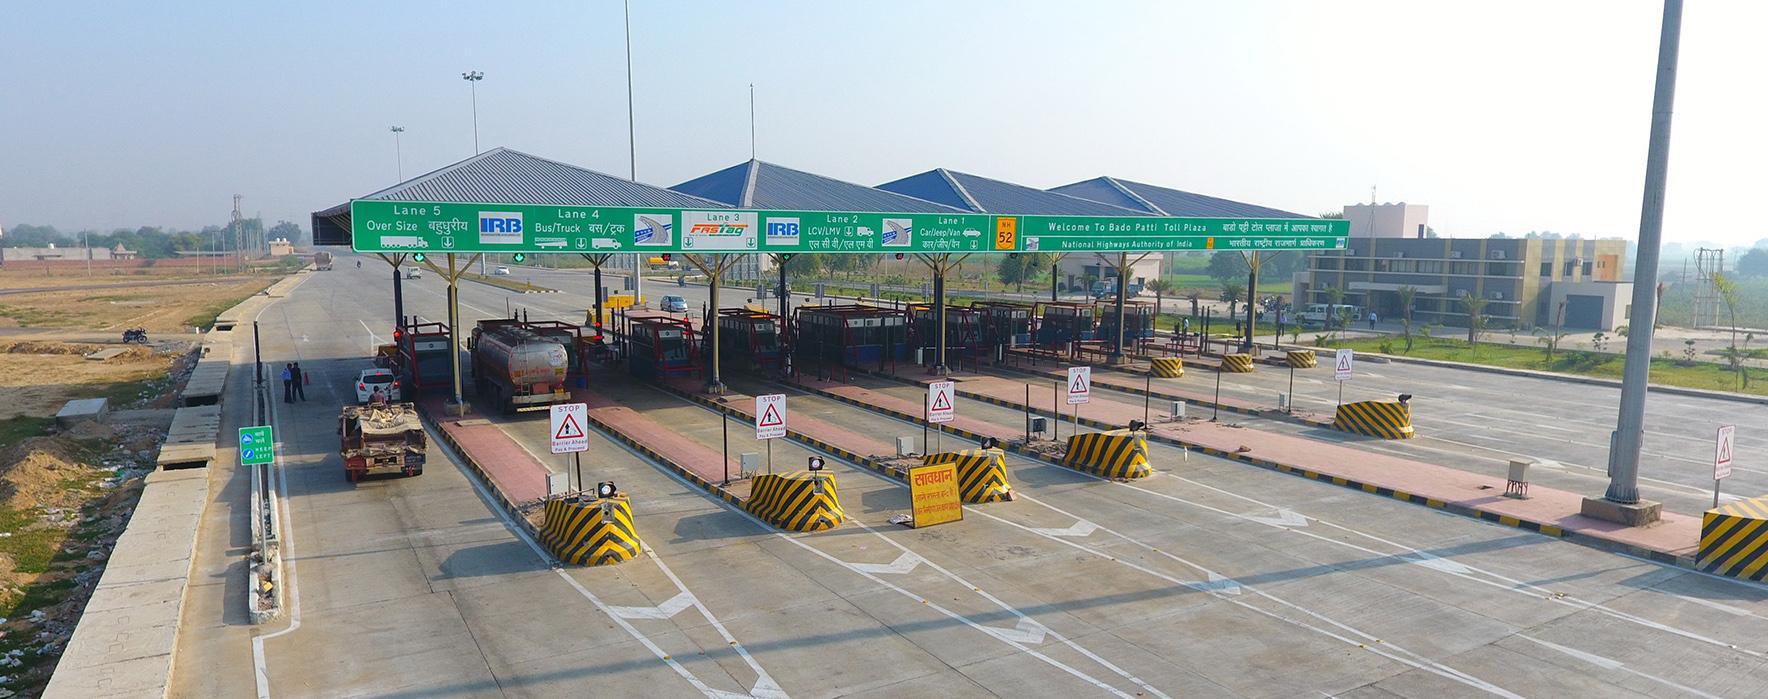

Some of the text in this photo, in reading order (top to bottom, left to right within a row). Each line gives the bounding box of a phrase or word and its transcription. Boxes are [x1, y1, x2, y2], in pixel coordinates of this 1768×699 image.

[394, 206, 441, 215] Lane 5
[558, 209, 599, 219] Lane 4
[707, 213, 729, 221] Lane
[827, 214, 858, 223] Lane 2
[938, 216, 958, 224] Lane
[366, 220, 418, 230] Over Size
[480, 218, 522, 233] IRB
[535, 223, 580, 233] Bus/Truck
[588, 223, 625, 235] बस/ट्रक
[768, 222, 799, 236] IRB
[1049, 222, 1090, 231] Welcome
[1095, 223, 1105, 232] To
[1109, 223, 1131, 232] Bado
[1135, 223, 1157, 231] Patti
[1251, 222, 1263, 232] टोल
[1311, 224, 1326, 232] स्वागत
[1328, 222, 1332, 232] है
[808, 226, 840, 236] LCV/LMV
[920, 228, 960, 237] Car/Jeep/Van
[999, 232, 1012, 243] 52
[809, 240, 820, 250] एल
[822, 237, 830, 249] सी
[856, 240, 865, 250] एम
[1062, 240, 1094, 248] National
[1097, 241, 1129, 249] Highways
[1132, 240, 1163, 249] Authority
[914, 469, 953, 486] सावधान
